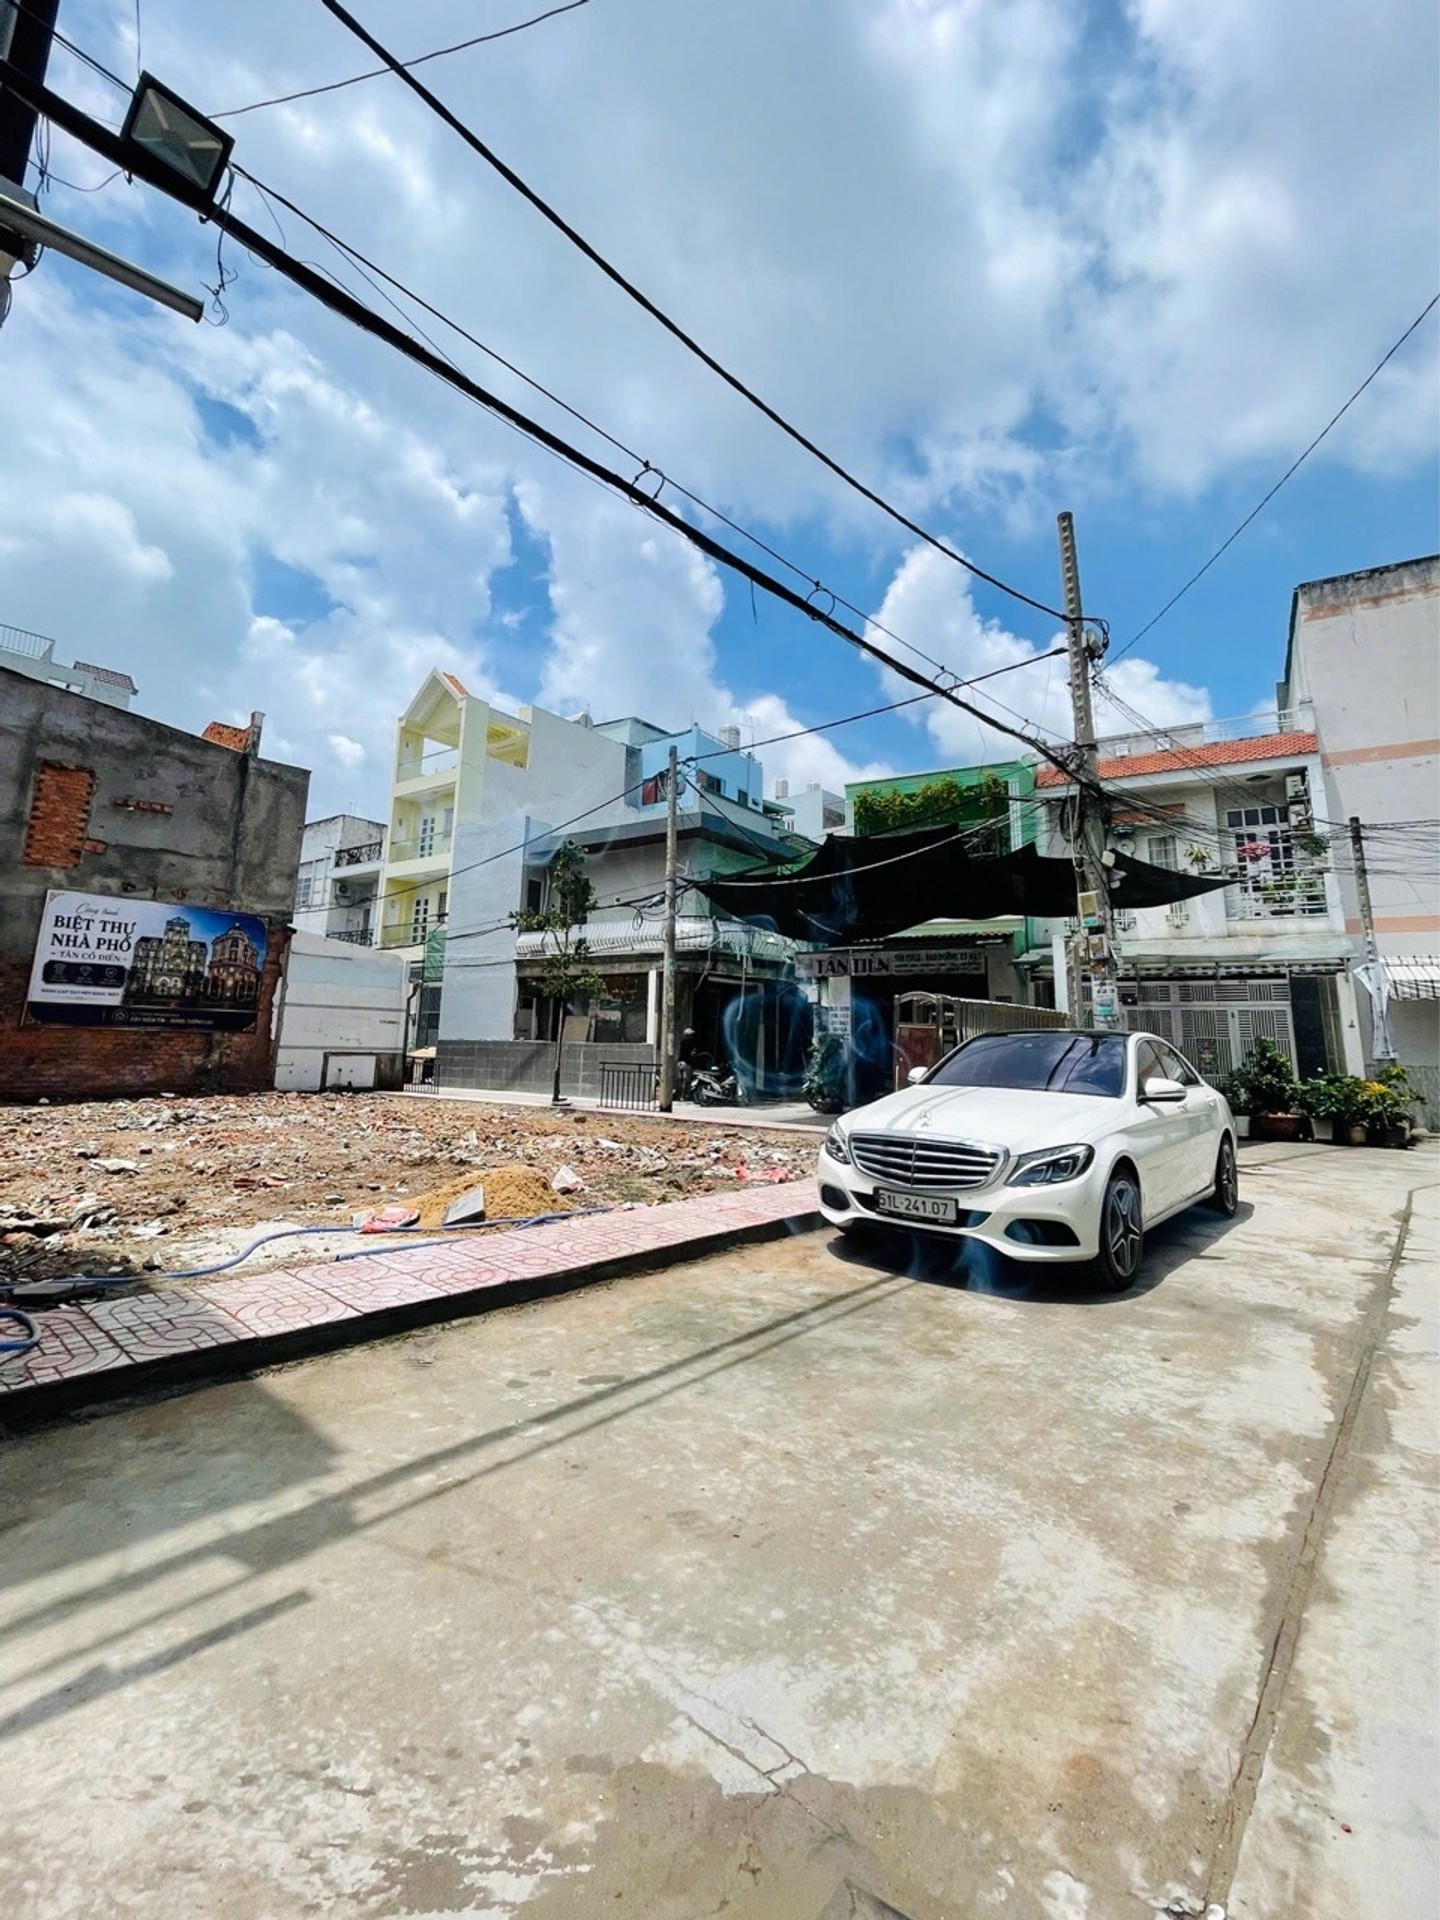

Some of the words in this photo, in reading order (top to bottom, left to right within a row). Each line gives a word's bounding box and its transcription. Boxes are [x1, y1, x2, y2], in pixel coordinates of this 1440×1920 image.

[53, 915, 95, 933] BIỆT
[99, 919, 137, 936] THỰ
[50, 933, 91, 949] NHÀ
[96, 935, 132, 952] PHỐ
[815, 956, 849, 975] TÂN
